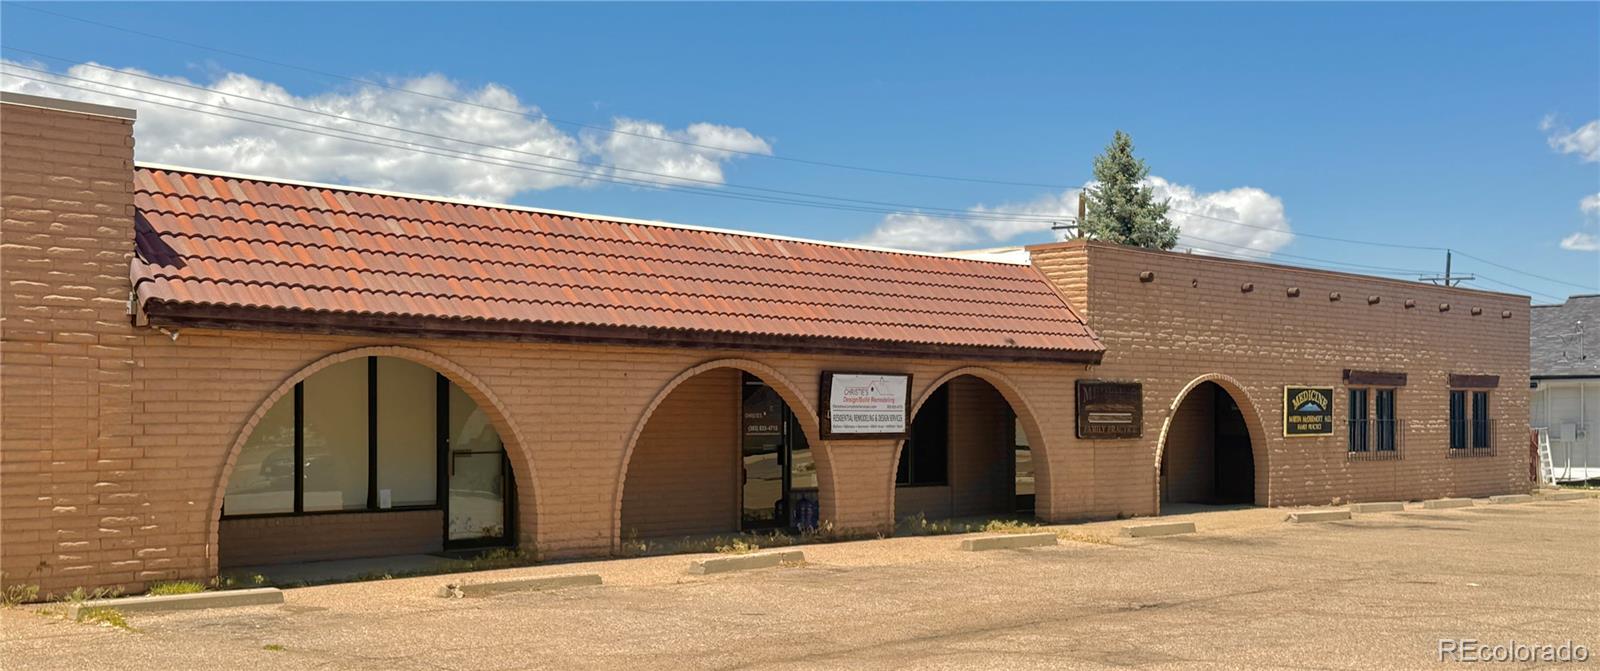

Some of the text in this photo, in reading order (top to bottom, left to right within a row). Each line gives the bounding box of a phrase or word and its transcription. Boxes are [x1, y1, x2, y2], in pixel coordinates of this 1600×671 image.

[843, 388, 869, 396] CHRISTIE'S
[871, 396, 895, 404] Remodeling
[1292, 389, 1328, 410] MEDICINE
[832, 413, 853, 422] RESIDENTIAL
[854, 413, 875, 422] REMODELING
[1082, 424, 1105, 433] FAMILY
